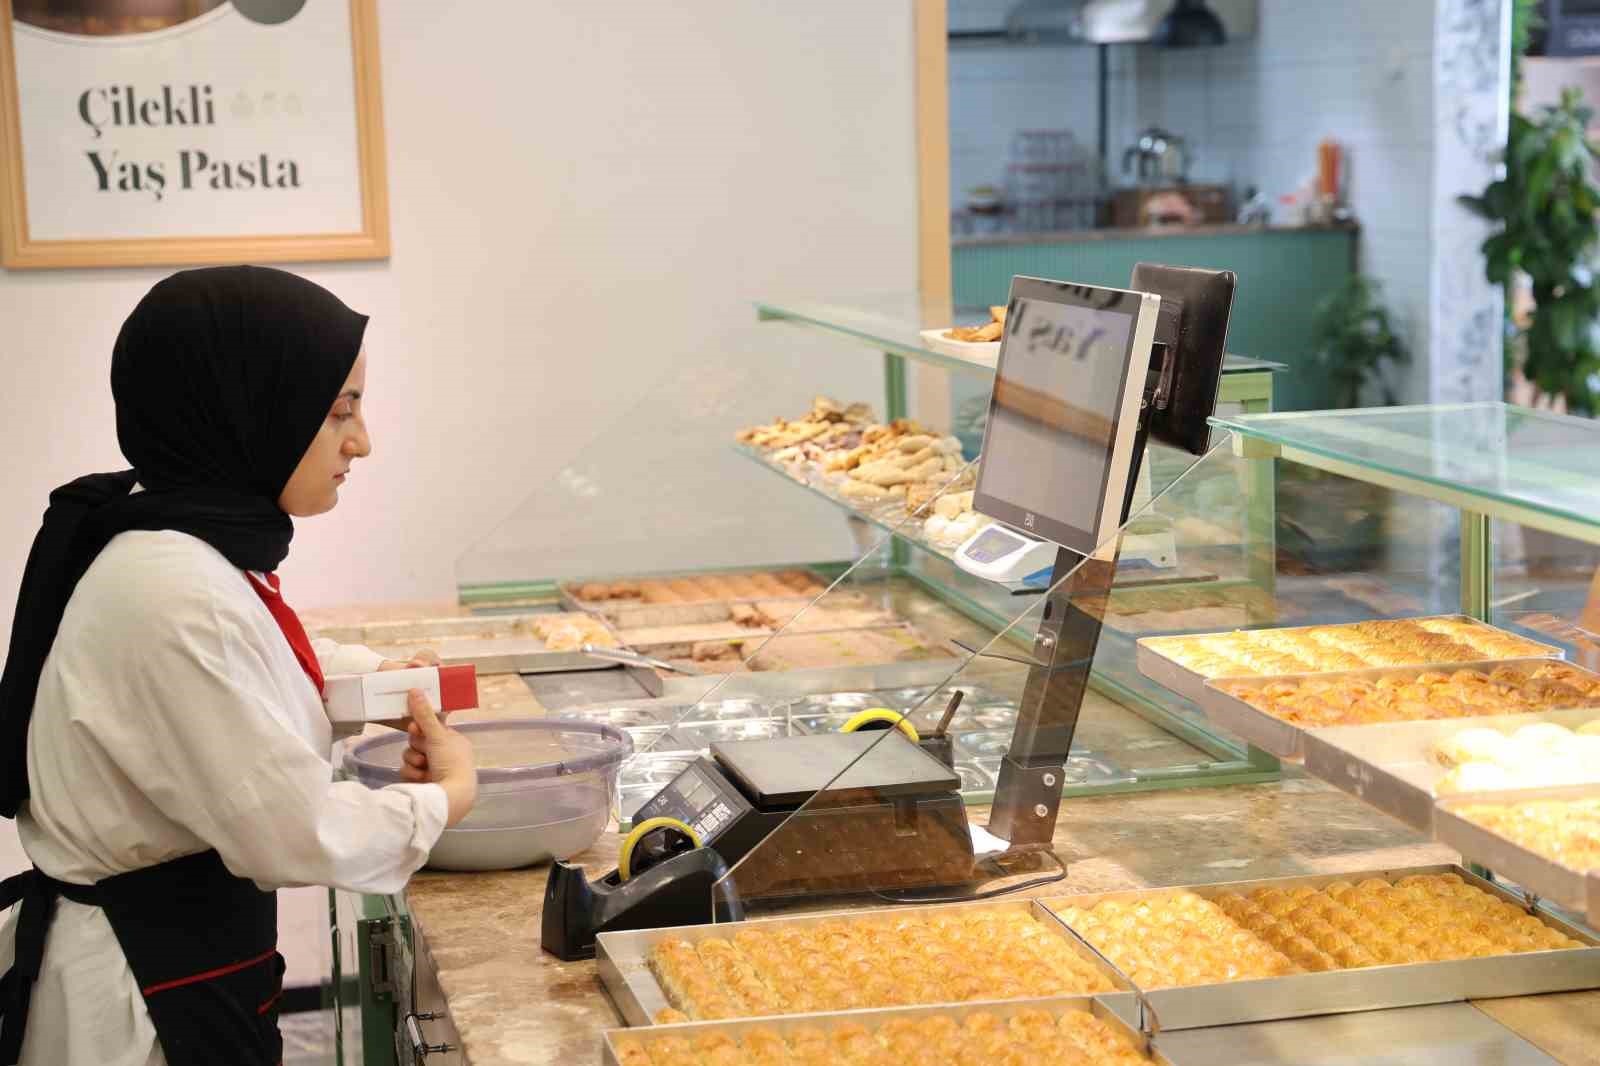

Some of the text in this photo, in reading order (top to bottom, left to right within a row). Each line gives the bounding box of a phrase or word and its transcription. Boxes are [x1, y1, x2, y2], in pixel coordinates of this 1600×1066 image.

[77, 85, 215, 139] Çilekli
[86, 150, 301, 200] Yaş Pasta
